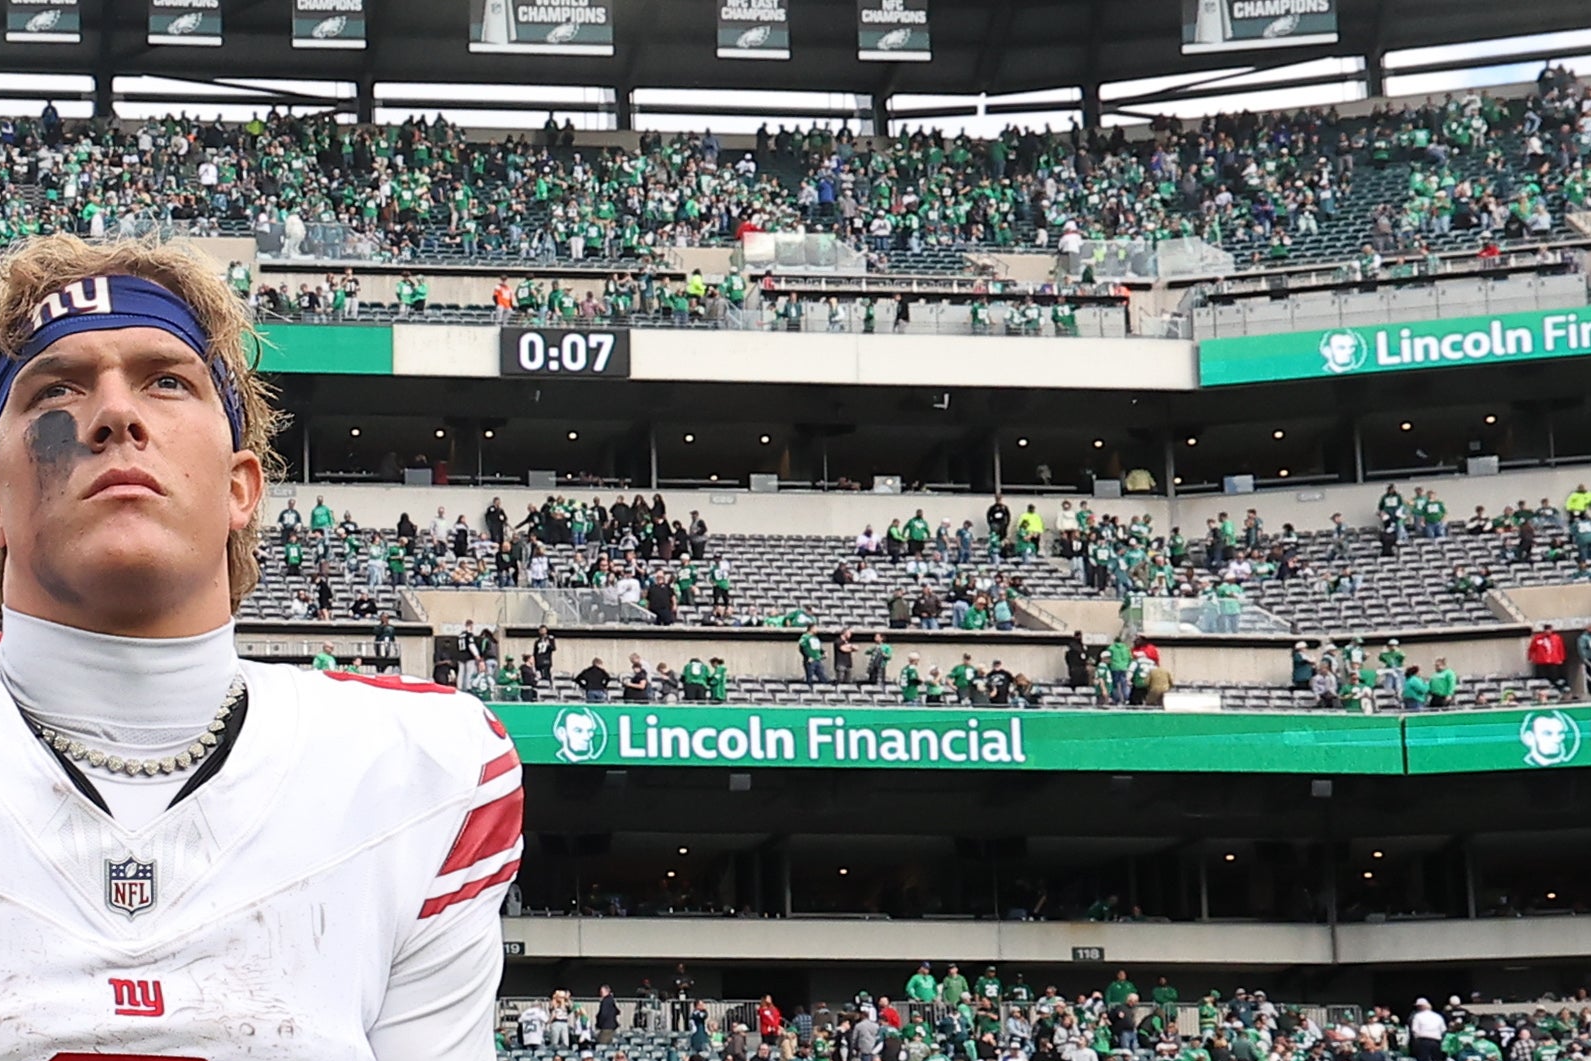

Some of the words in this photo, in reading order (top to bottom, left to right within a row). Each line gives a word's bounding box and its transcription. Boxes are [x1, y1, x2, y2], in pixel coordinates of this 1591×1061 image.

[517, 6, 606, 24] CHAMPIONS
[721, 7, 786, 22] CHAMPIONS
[861, 9, 927, 24] CHAMPIONS
[1233, 0, 1329, 18] CHAMPIONS
[519, 332, 615, 371] 0:07
[1376, 320, 1533, 365] Lincoln
[619, 714, 796, 760] Lincoln
[808, 717, 1026, 763] Financial
[114, 882, 150, 908] NFL
[1077, 948, 1100, 960] 118
[108, 978, 165, 1017] ny
